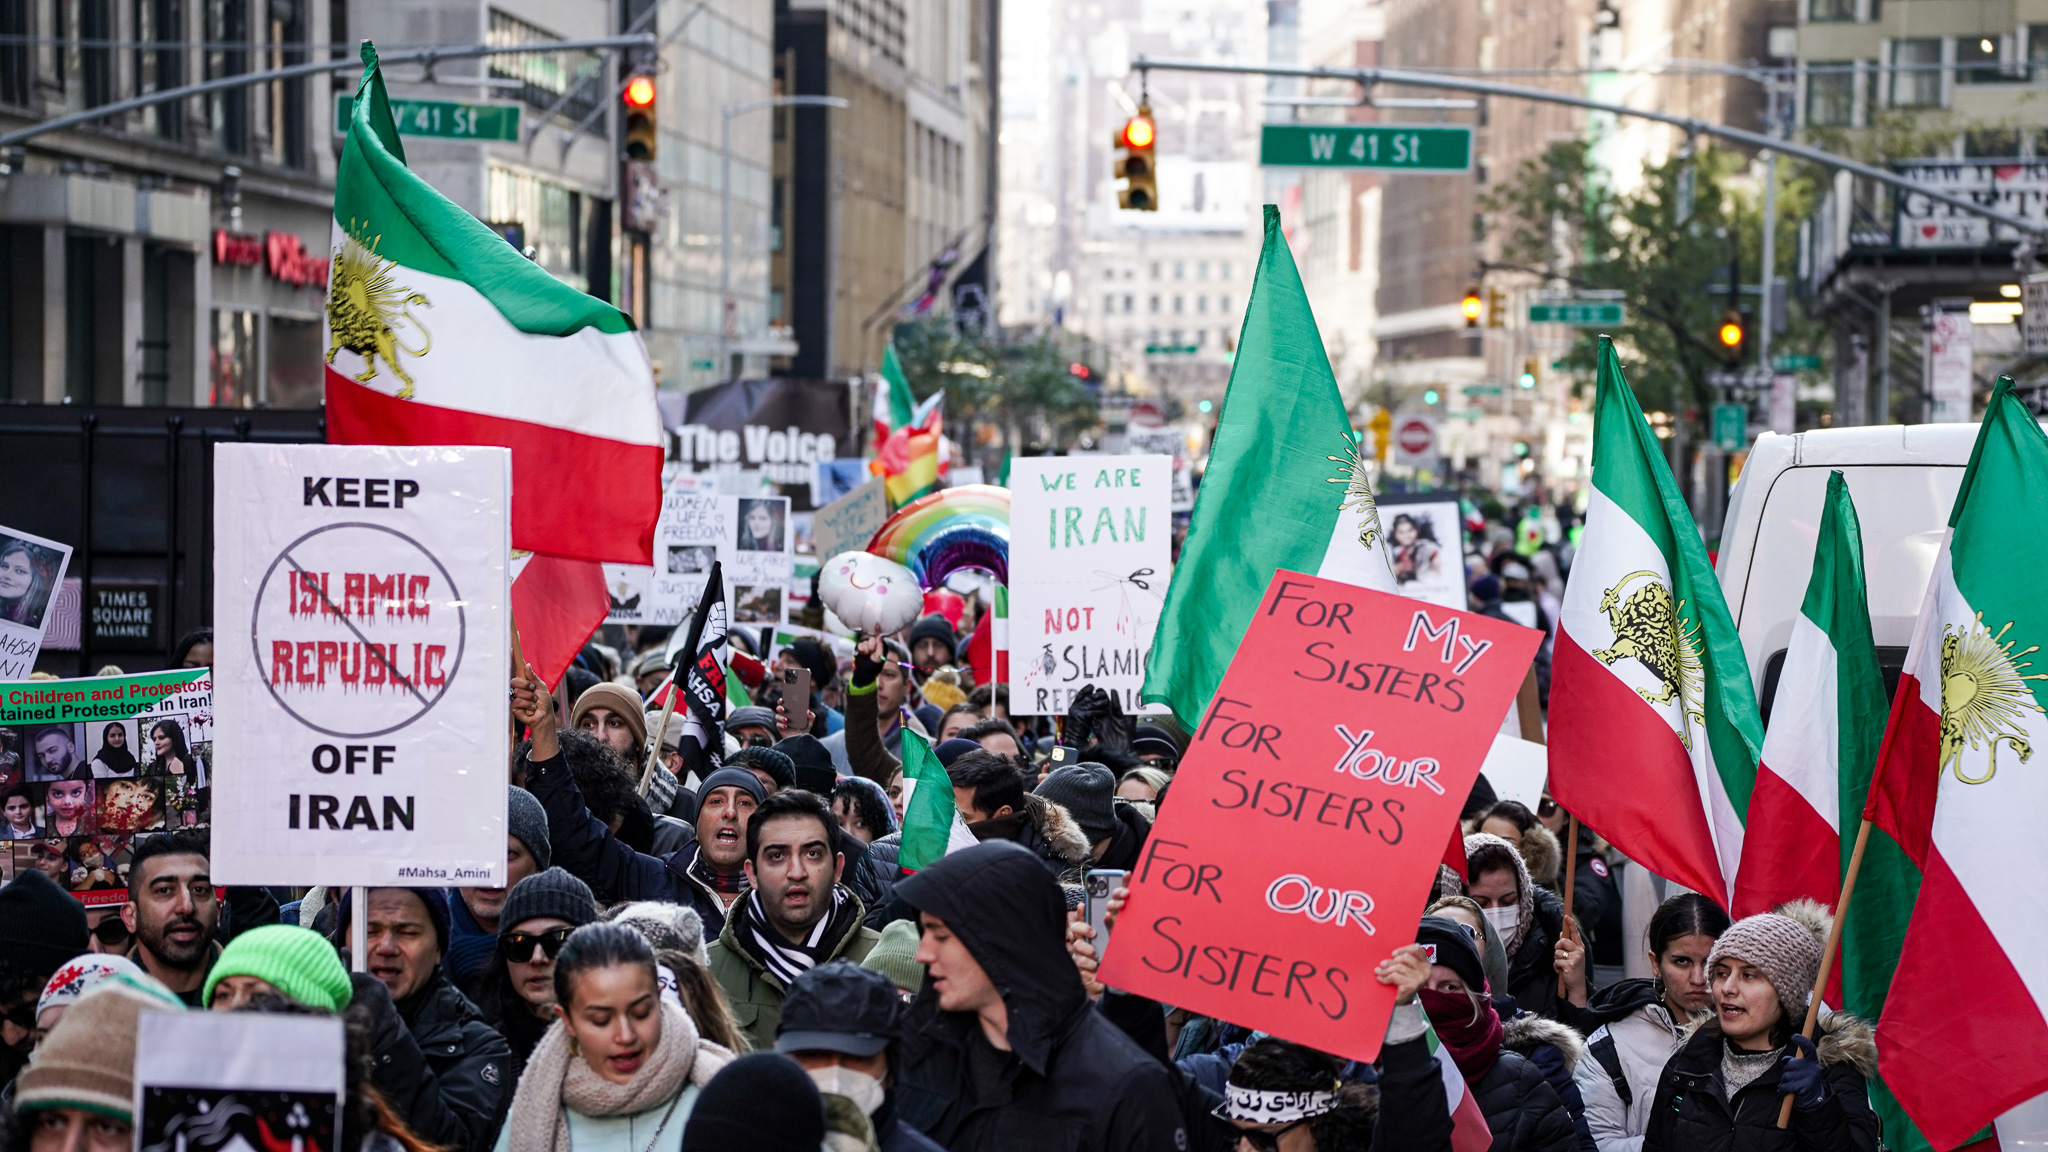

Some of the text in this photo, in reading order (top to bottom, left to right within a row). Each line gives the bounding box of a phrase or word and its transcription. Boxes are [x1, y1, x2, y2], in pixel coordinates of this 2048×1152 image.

[415, 107, 441, 132] 41
[453, 108, 478, 135] St
[1309, 132, 1420, 163] W 41 St
[675, 424, 740, 463] The
[744, 425, 836, 464] Voice
[303, 476, 420, 509] KEEP
[1040, 468, 1142, 492] WE ARE
[662, 525, 728, 541] FREEDOM
[1049, 506, 1147, 549] IRAN
[98, 591, 148, 607] TIMES
[288, 570, 431, 627] ISLAMIC
[1267, 581, 1354, 635] FOR
[92, 608, 152, 625] SQUARE
[96, 624, 149, 637] ALLIANCE
[1045, 606, 1095, 635] NOT
[0, 633, 36, 658] AHSA
[271, 640, 447, 696] REPUBLIC
[1293, 641, 1465, 713] SISTERS
[0, 693, 212, 721] tained Protestors in Iran!
[9, 689, 85, 705] Children
[91, 685, 124, 701] and
[129, 679, 212, 698] Protestors
[312, 744, 396, 775] OFF
[1198, 696, 1446, 796] FOR YOUR
[289, 794, 415, 831] IRAN
[1212, 769, 1406, 845] SISTERS
[398, 867, 491, 881] #Mahsa_Amini
[1140, 838, 1376, 936] FOR OUR
[81, 892, 129, 905] Freedo
[1141, 915, 1349, 1021] SISTERS
